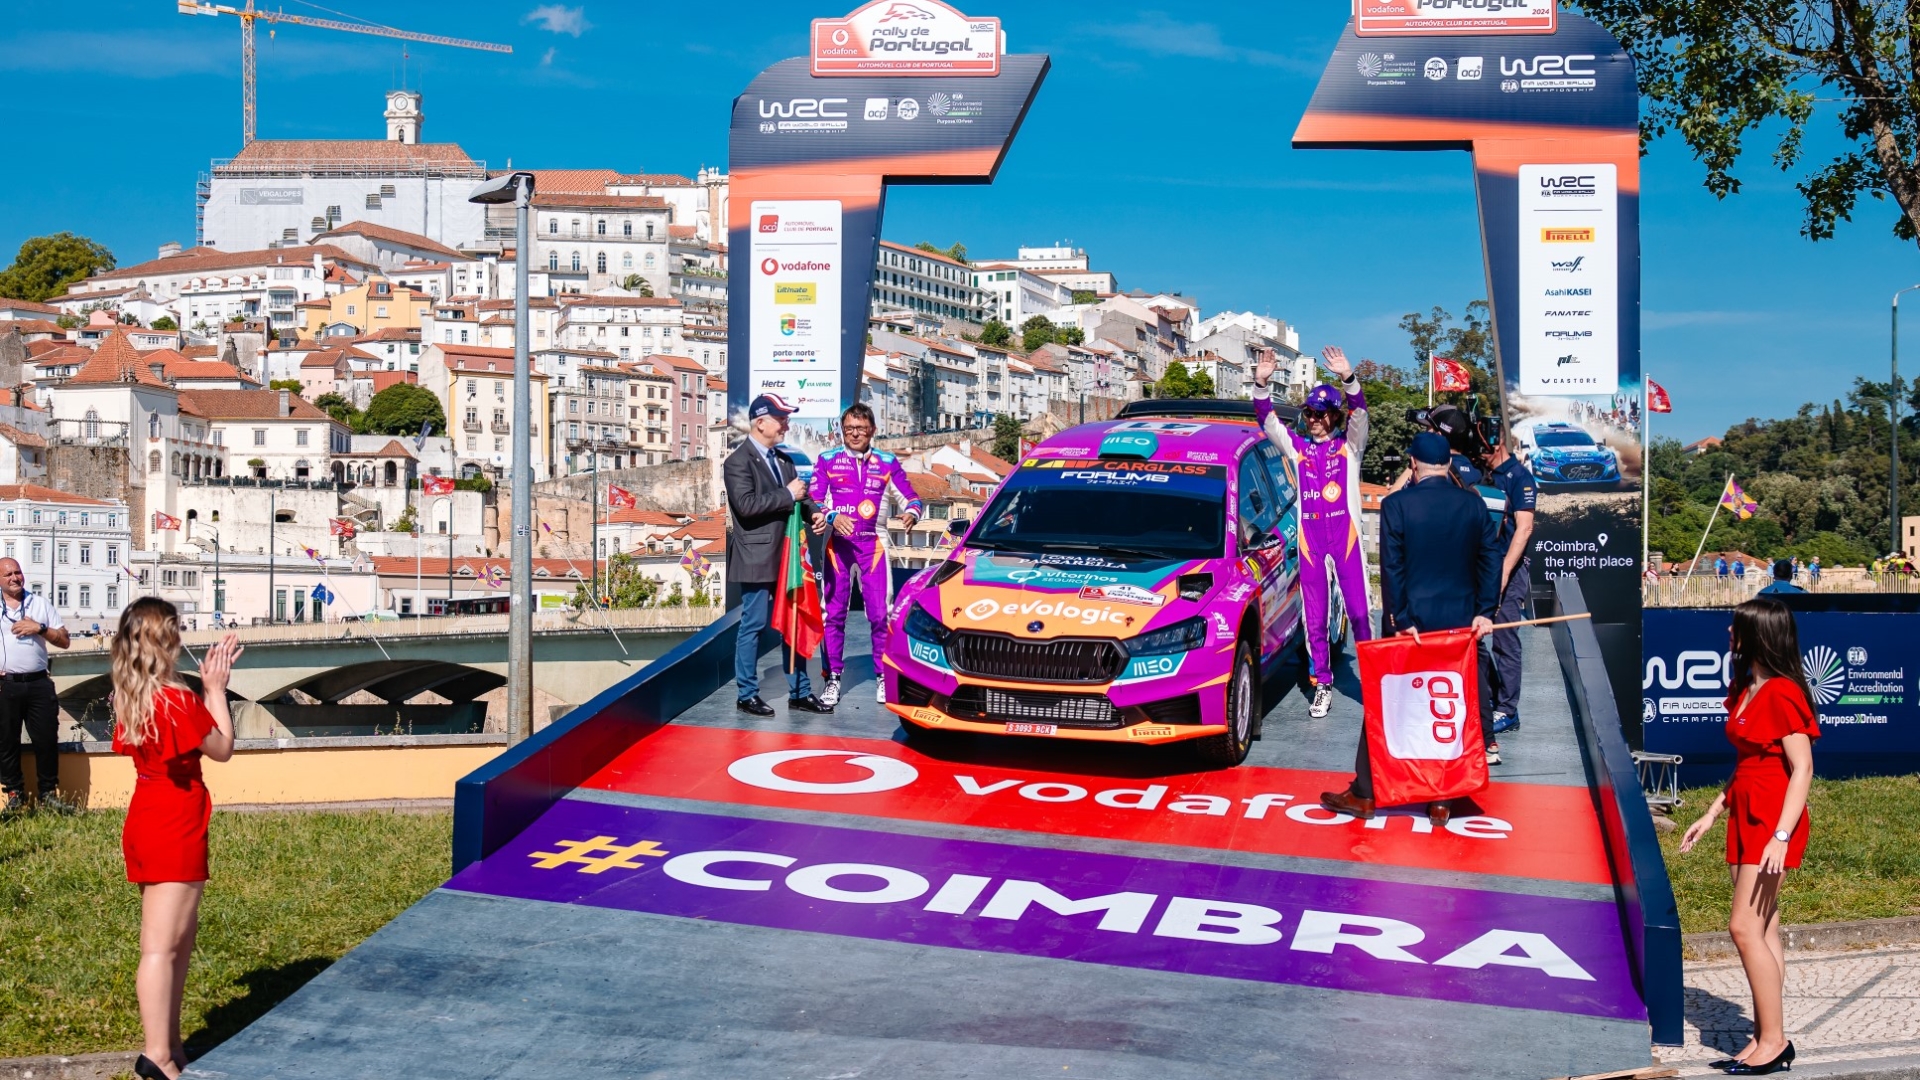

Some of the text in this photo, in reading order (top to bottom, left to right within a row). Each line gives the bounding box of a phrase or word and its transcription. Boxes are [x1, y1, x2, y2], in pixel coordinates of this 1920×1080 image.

[1367, 6, 1405, 14] vodafone
[1404, 19, 1445, 27] AUTOMÓVEL
[872, 26, 930, 38] rally de
[869, 38, 973, 55] Portugal
[857, 60, 894, 69] AUTOMÓVEL
[1500, 55, 1596, 76] WRC
[1424, 70, 1447, 78] FPAK
[1461, 69, 1480, 78] acp
[1501, 82, 1518, 91] FIA
[759, 98, 848, 118] WRC
[868, 110, 886, 118] acp
[1541, 176, 1596, 188] WRC
[762, 224, 777, 232] acp
[1546, 230, 1590, 240] PIRELLI
[781, 260, 830, 271] vodafone
[777, 286, 808, 294] ultimate
[1544, 288, 1592, 296] AsahiKASEI
[773, 350, 793, 358] porto
[761, 380, 786, 388] Hertz
[1104, 436, 1150, 446] MEO
[1104, 461, 1208, 475] CARGLASS
[1568, 466, 1599, 480] Ford
[1060, 471, 1170, 483] FORUM8
[1303, 490, 1320, 501] galp
[836, 504, 856, 514] galp
[1535, 540, 1599, 552] #Coimbra,
[1018, 558, 1128, 569] PASSARELLA
[1544, 556, 1634, 570] the right place
[1046, 570, 1118, 582] vitorinos
[1544, 570, 1557, 580] to
[1002, 600, 1125, 625] evologic
[913, 642, 938, 662] MEO
[1848, 650, 1866, 662] FIA
[1134, 658, 1172, 676] MEO
[1642, 650, 1732, 690] WR
[1848, 666, 1903, 679] Environmental
[1848, 680, 1904, 692] Accreditation
[1427, 676, 1459, 744] acp
[1662, 702, 1722, 710] FIA WORLD
[914, 710, 942, 722] PIRELLI
[1014, 724, 1032, 732] 3093
[1036, 725, 1051, 734] BCK
[1132, 726, 1171, 736] PIRELLI
[950, 774, 1515, 840] vodafone
[529, 834, 1598, 982] #COIMBRA
